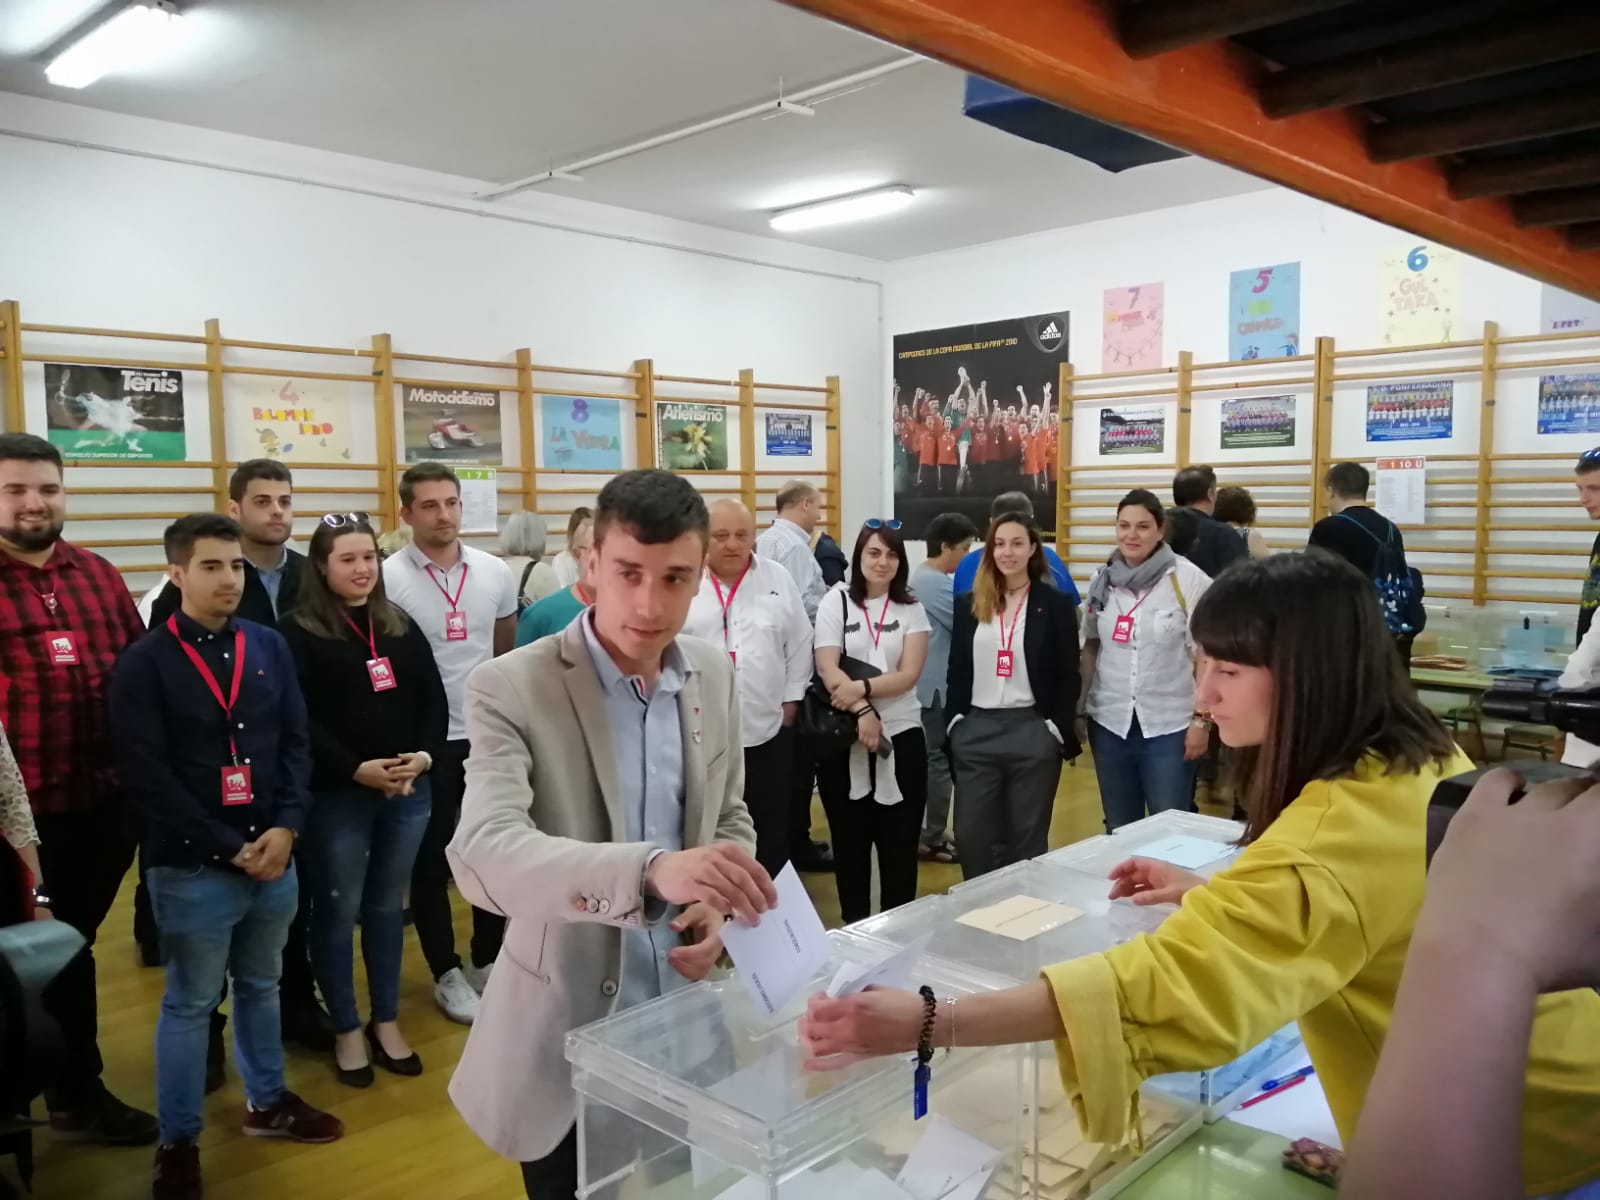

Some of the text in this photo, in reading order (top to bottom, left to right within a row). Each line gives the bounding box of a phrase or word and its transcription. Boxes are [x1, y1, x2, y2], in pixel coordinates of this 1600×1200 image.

[1407, 246, 1428, 272] 6
[1252, 269, 1273, 293] 5
[1127, 287, 1140, 309] 7
[940, 346, 953, 354] COPA
[981, 341, 989, 349] LA
[1005, 337, 1018, 346] 2010
[1040, 332, 1062, 340] adidas
[279, 379, 300, 405] 4
[409, 388, 495, 406] Motociclismo
[571, 398, 590, 423] 8
